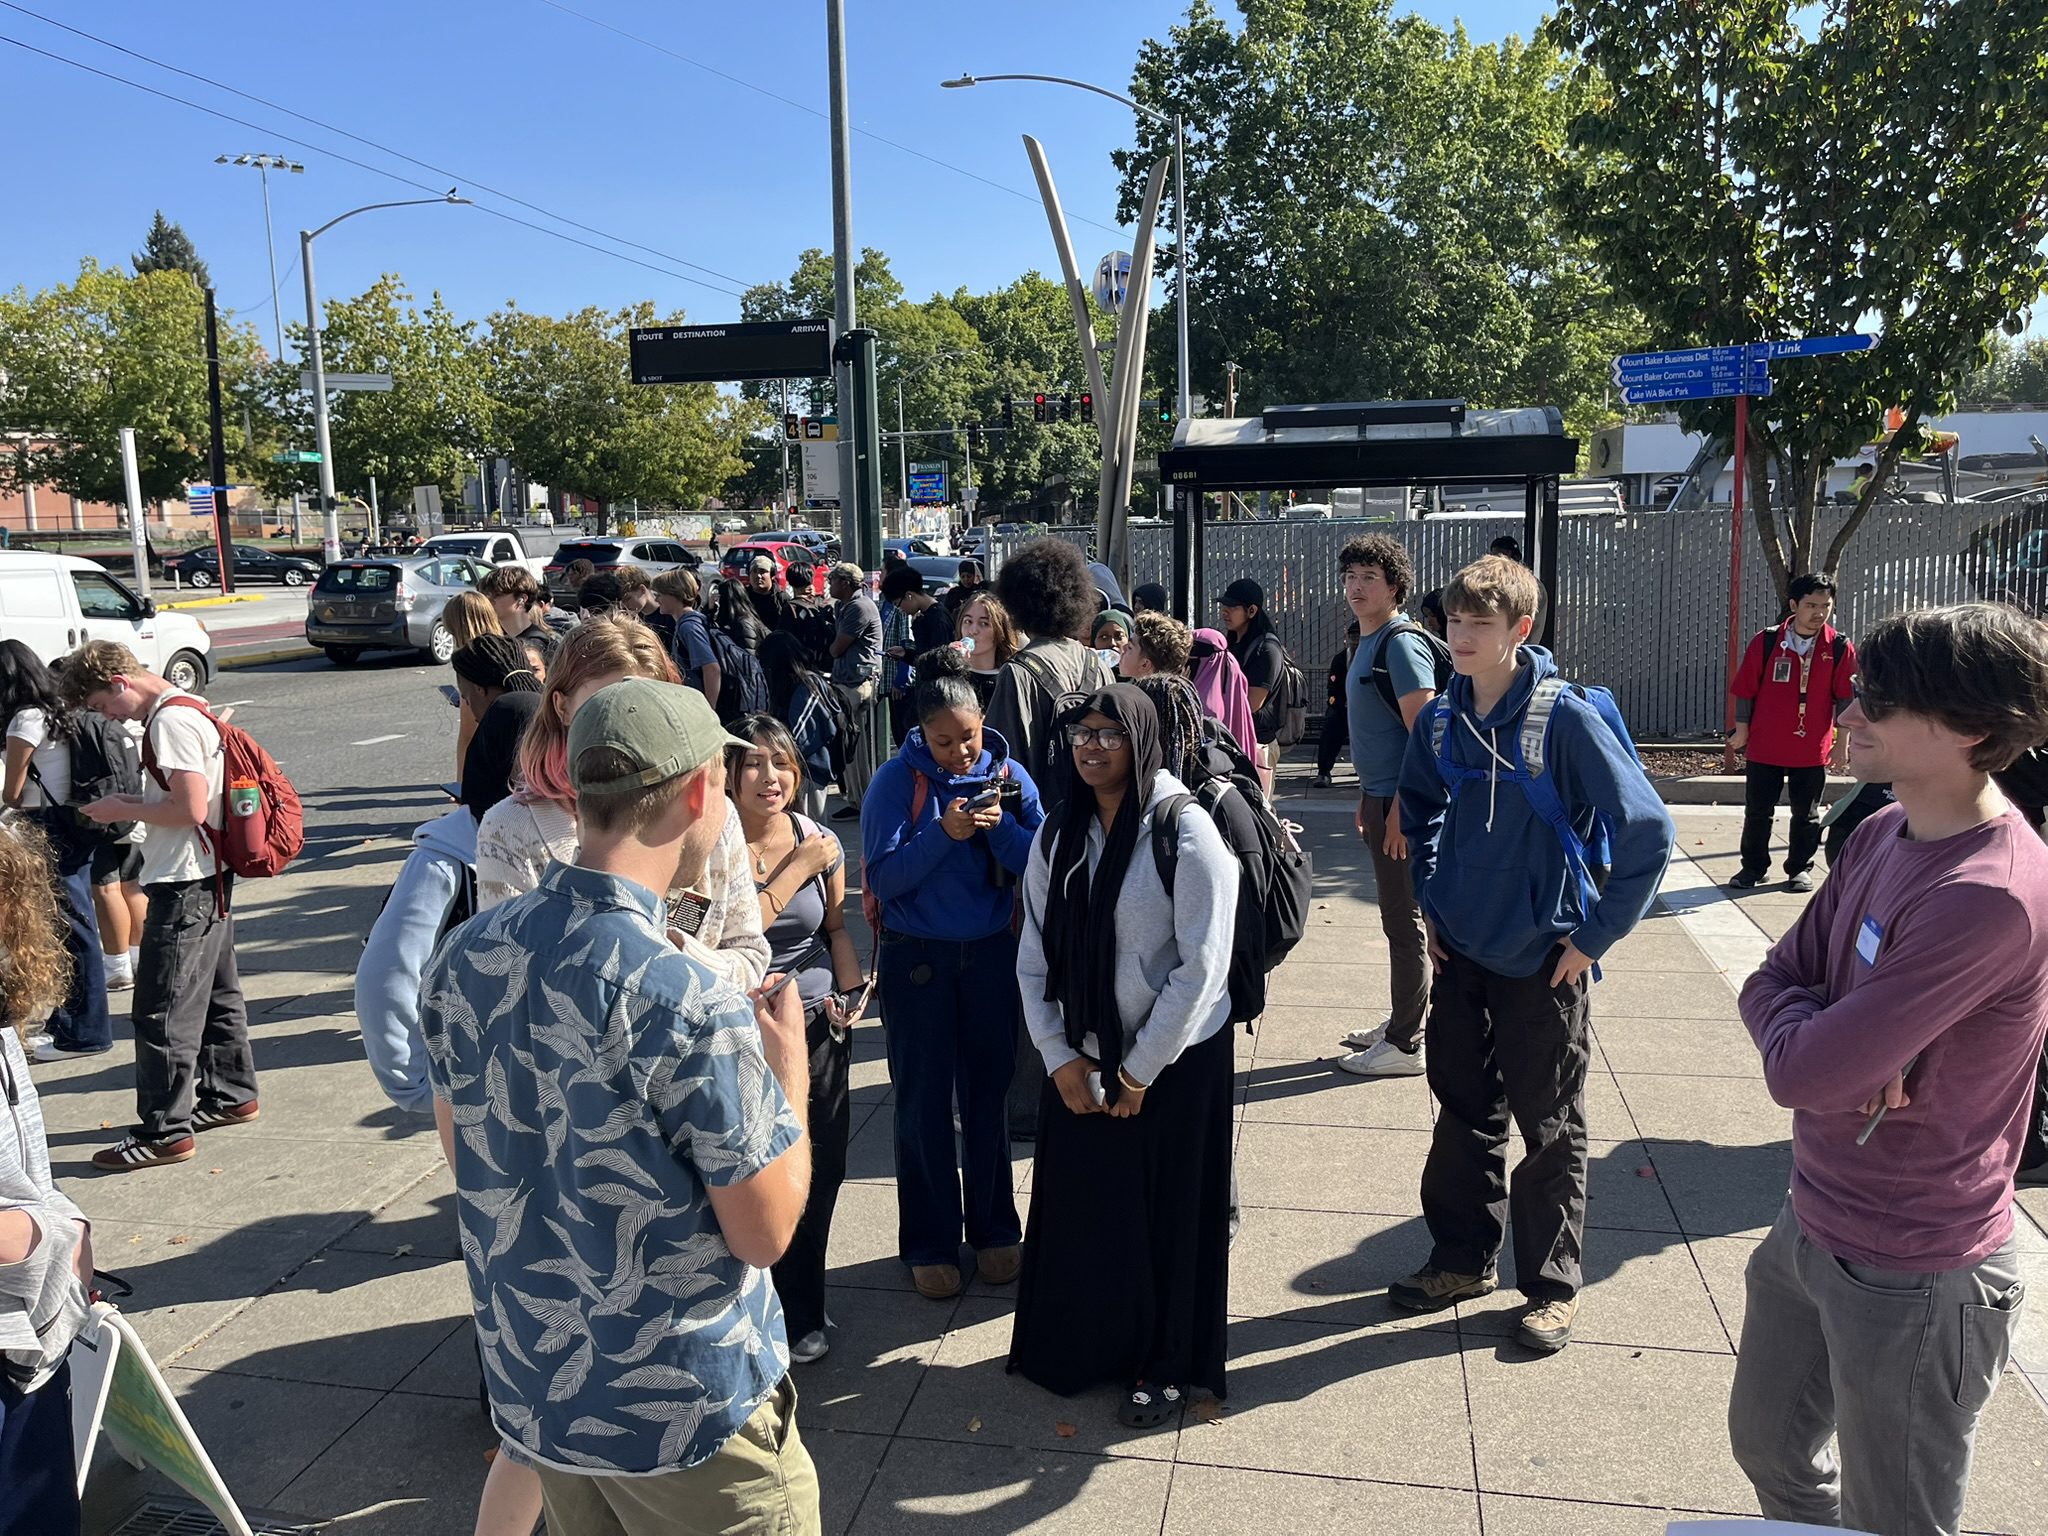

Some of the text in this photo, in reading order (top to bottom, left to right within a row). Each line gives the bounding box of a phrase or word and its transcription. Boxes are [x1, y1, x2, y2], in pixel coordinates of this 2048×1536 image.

[637, 324, 827, 341] ROUTE DESTINATION ARRIVAL
[1777, 343, 1801, 354] Link
[1621, 352, 1710, 367] Mount Baker Business Dist.
[1621, 374, 1643, 383] Mount
[1643, 372, 1663, 382] Baker
[1687, 369, 1704, 378] Club
[1629, 387, 1689, 400] Lake WA Blvd. Park
[788, 424, 796, 437] 4
